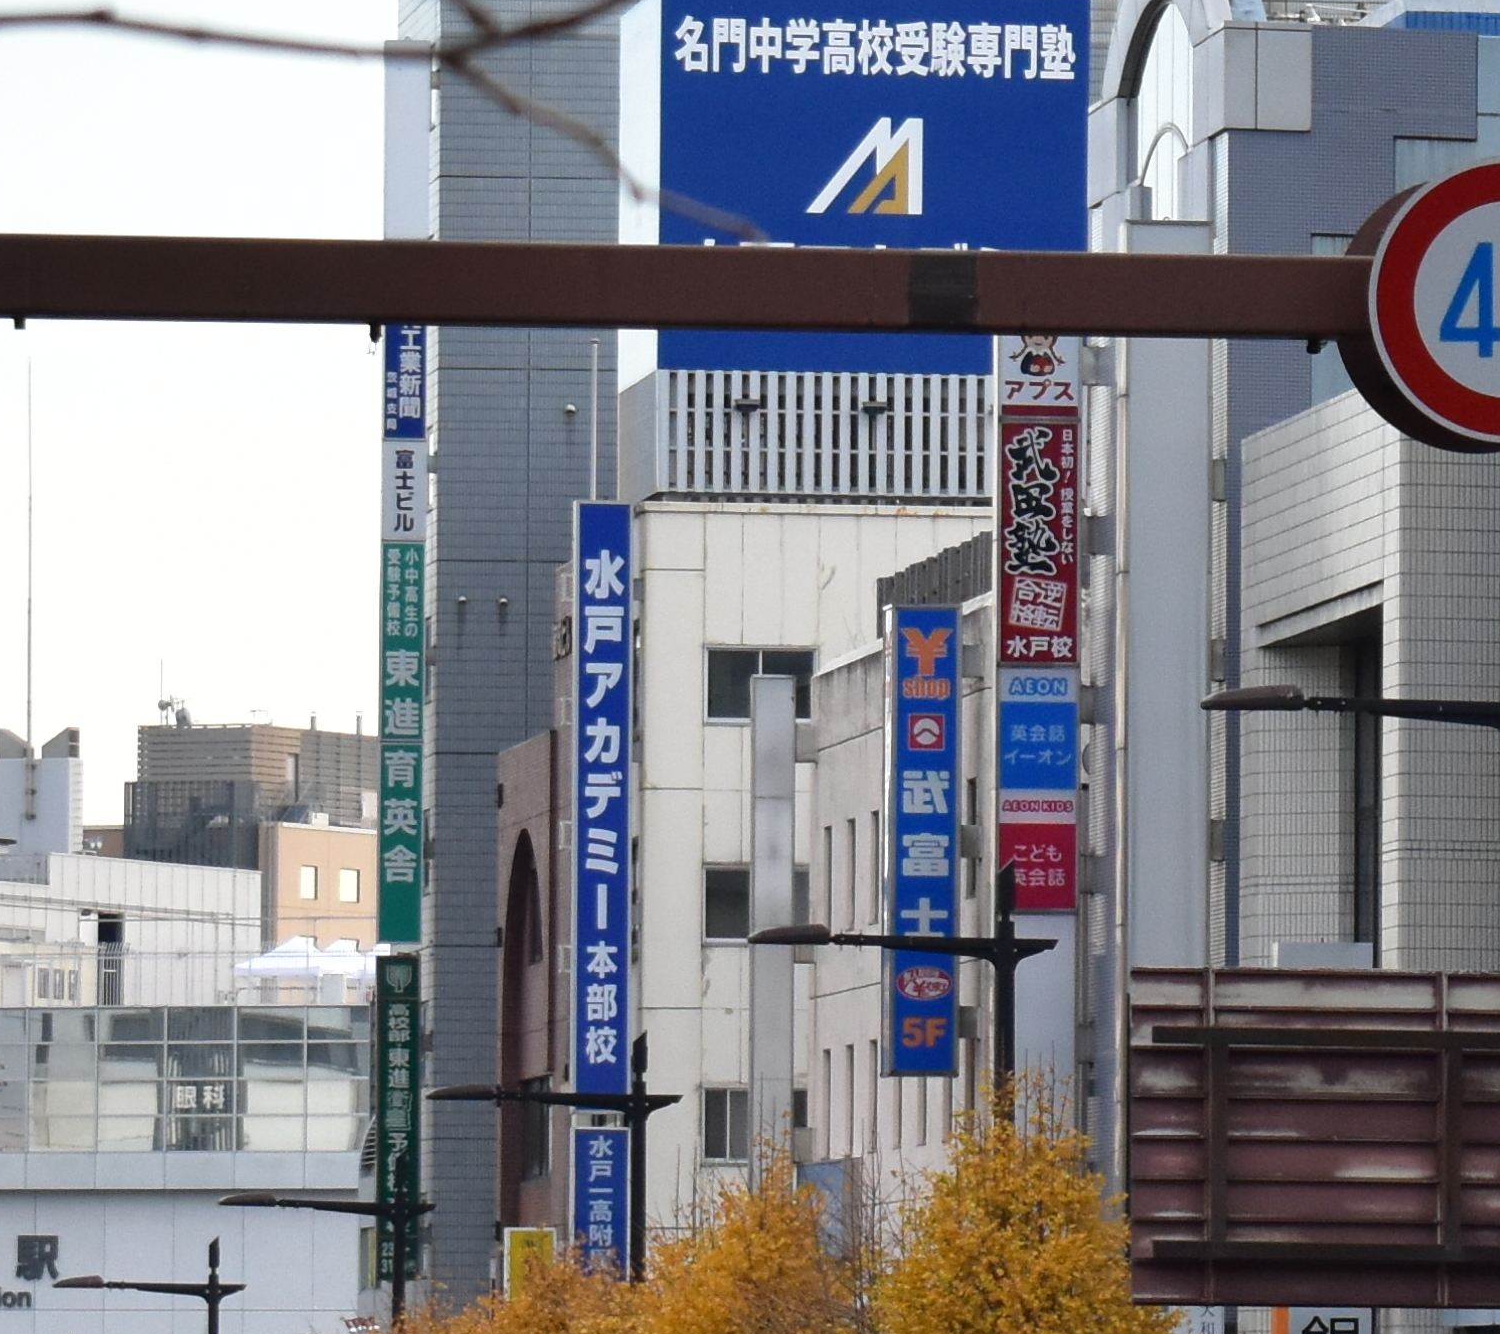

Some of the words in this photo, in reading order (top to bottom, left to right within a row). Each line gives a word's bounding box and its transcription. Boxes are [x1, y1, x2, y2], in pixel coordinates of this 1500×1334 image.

[674, 14, 1077, 81] 名門中学高校受験専門塾
[398, 326, 422, 419] 工業新聞
[393, 449, 415, 533] 富士ビル
[1005, 426, 1060, 575] 武田塾
[386, 547, 402, 637] 受験予備校
[404, 547, 420, 638] 小中高生の
[1007, 635, 1073, 659] 水戸校
[902, 677, 952, 701] shop
[1008, 677, 1069, 697] AEON
[1004, 748, 1072, 766] イーオン
[1010, 724, 1066, 742] 英会話
[381, 647, 421, 884] 東進育英舎
[584, 549, 624, 1066] 水戸アカデミー本部校
[1002, 799, 1040, 814] AEON
[1041, 798, 1074, 813] KIDS
[900, 770, 951, 938] 武富士
[1013, 845, 1062, 863] こども
[902, 1017, 949, 1048] 5F
[175, 1084, 226, 1111] 眼科
